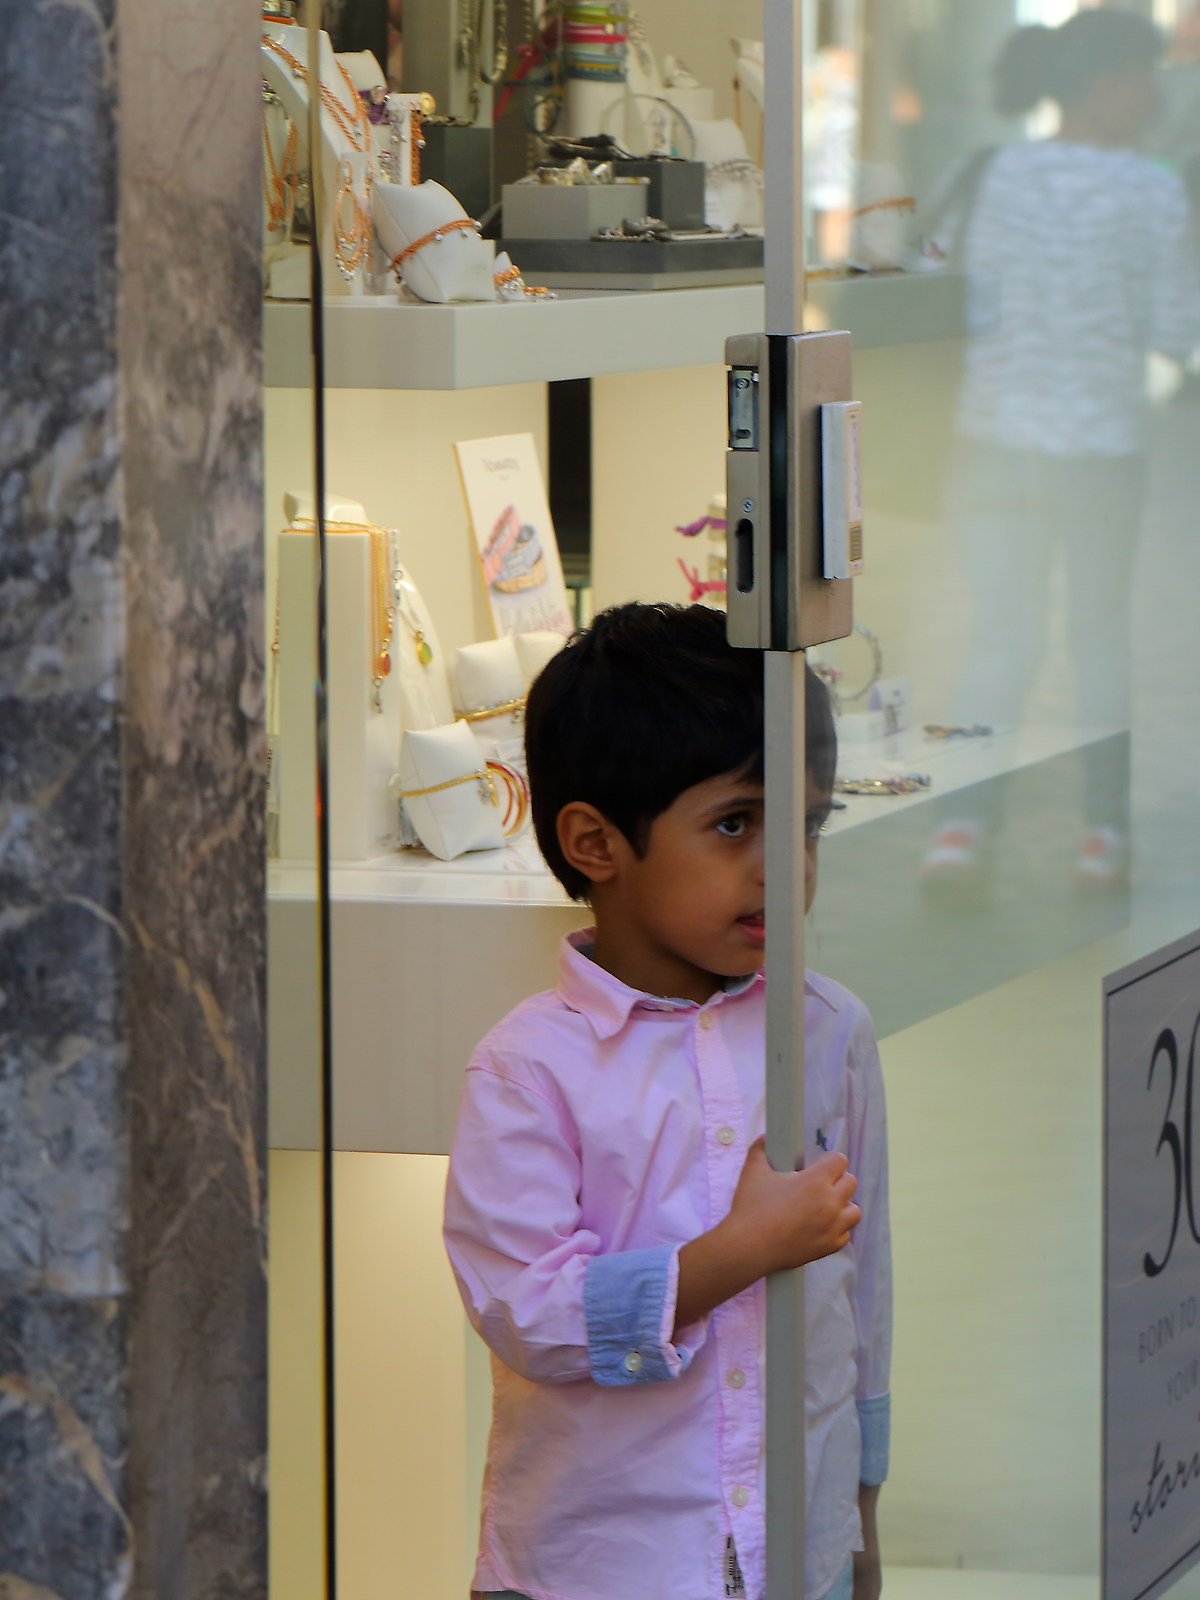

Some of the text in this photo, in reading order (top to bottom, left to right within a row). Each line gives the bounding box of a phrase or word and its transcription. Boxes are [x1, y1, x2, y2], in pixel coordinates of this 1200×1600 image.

[1138, 1310, 1174, 1364] BORN
[1179, 1295, 1197, 1332] TO
[1166, 1359, 1199, 1407] YOUR
